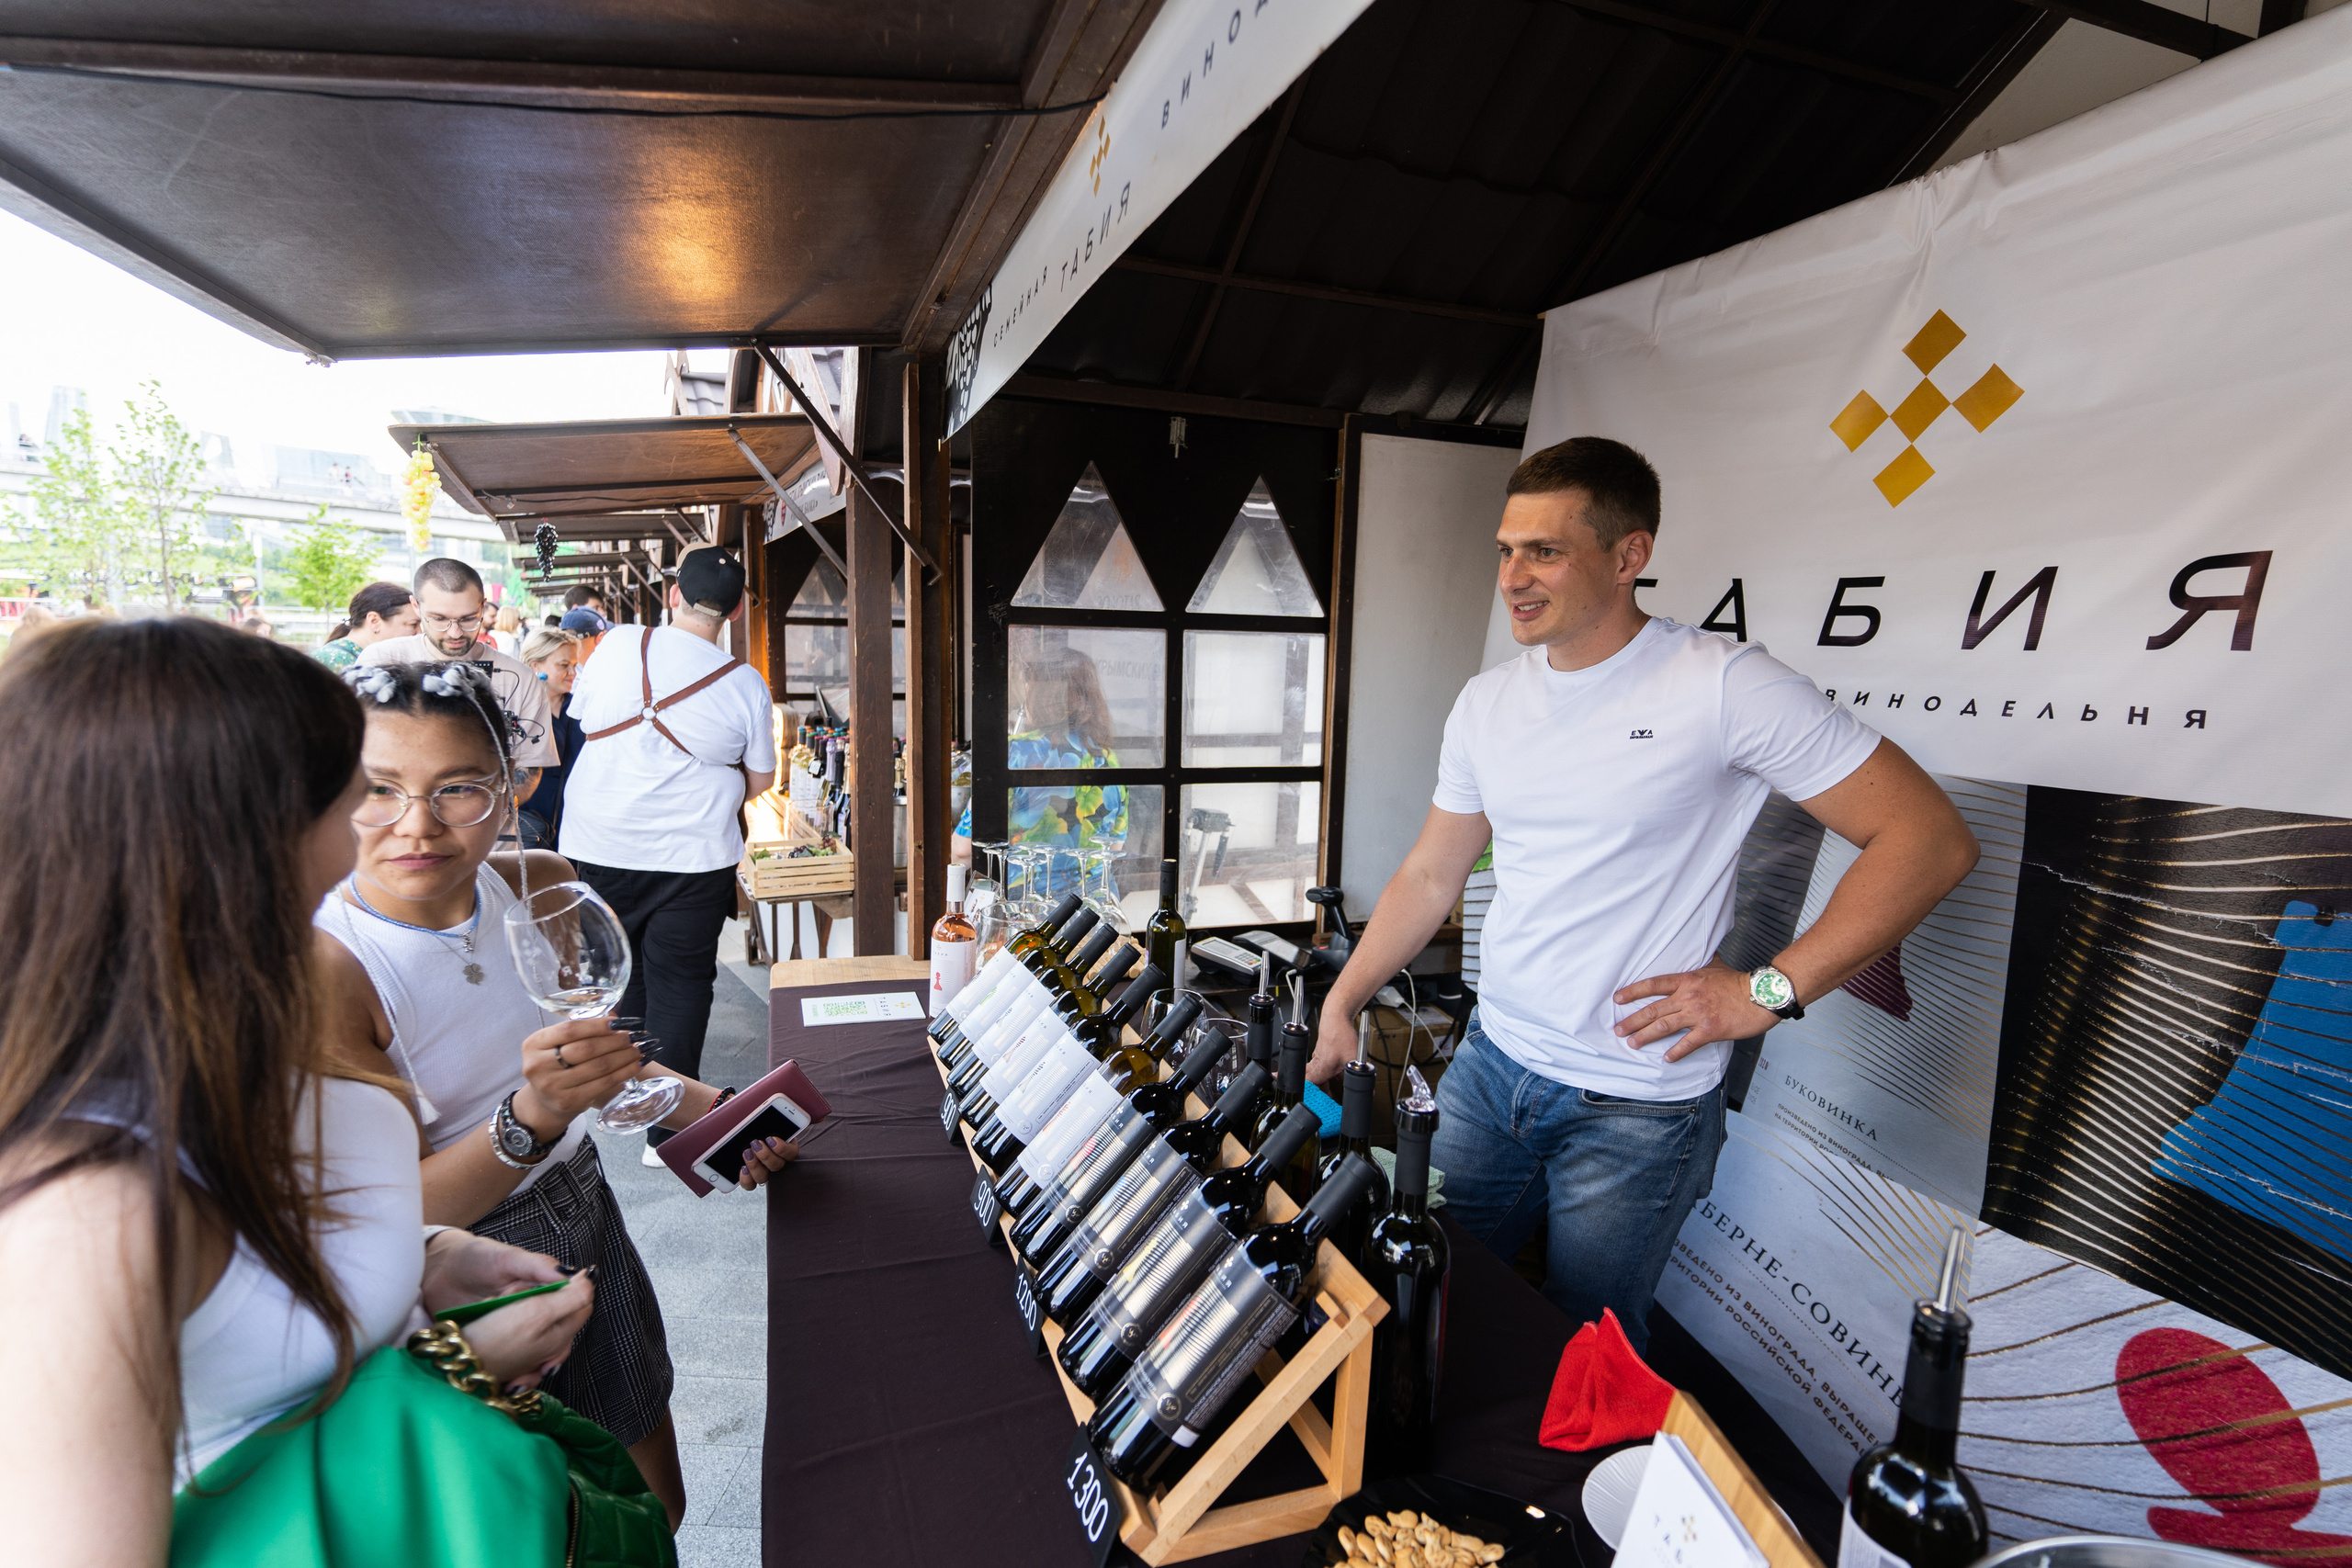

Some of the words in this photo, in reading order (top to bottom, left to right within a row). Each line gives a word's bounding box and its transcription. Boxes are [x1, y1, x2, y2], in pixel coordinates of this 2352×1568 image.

[994, 265, 1047, 348] СЕМЕЙНАЯ
[1060, 181, 1131, 293] ТАБИЯ
[940, 1092, 956, 1131] 900
[1777, 1103, 1817, 1133] ПРОИЗВЕДЕНО
[1818, 1128, 1827, 1140] ИЗ
[1782, 1117, 1818, 1146] ТЕРРИТОРИИ
[1785, 1075, 1877, 1141] БУКОВИНКА
[974, 1179, 996, 1227] 900
[1015, 1272, 1037, 1332] 1200
[1724, 1283, 1742, 1301] ИЗ
[1725, 1304, 1812, 1395] РОССИЙСКОЙ
[1066, 1451, 1109, 1543] 1300
